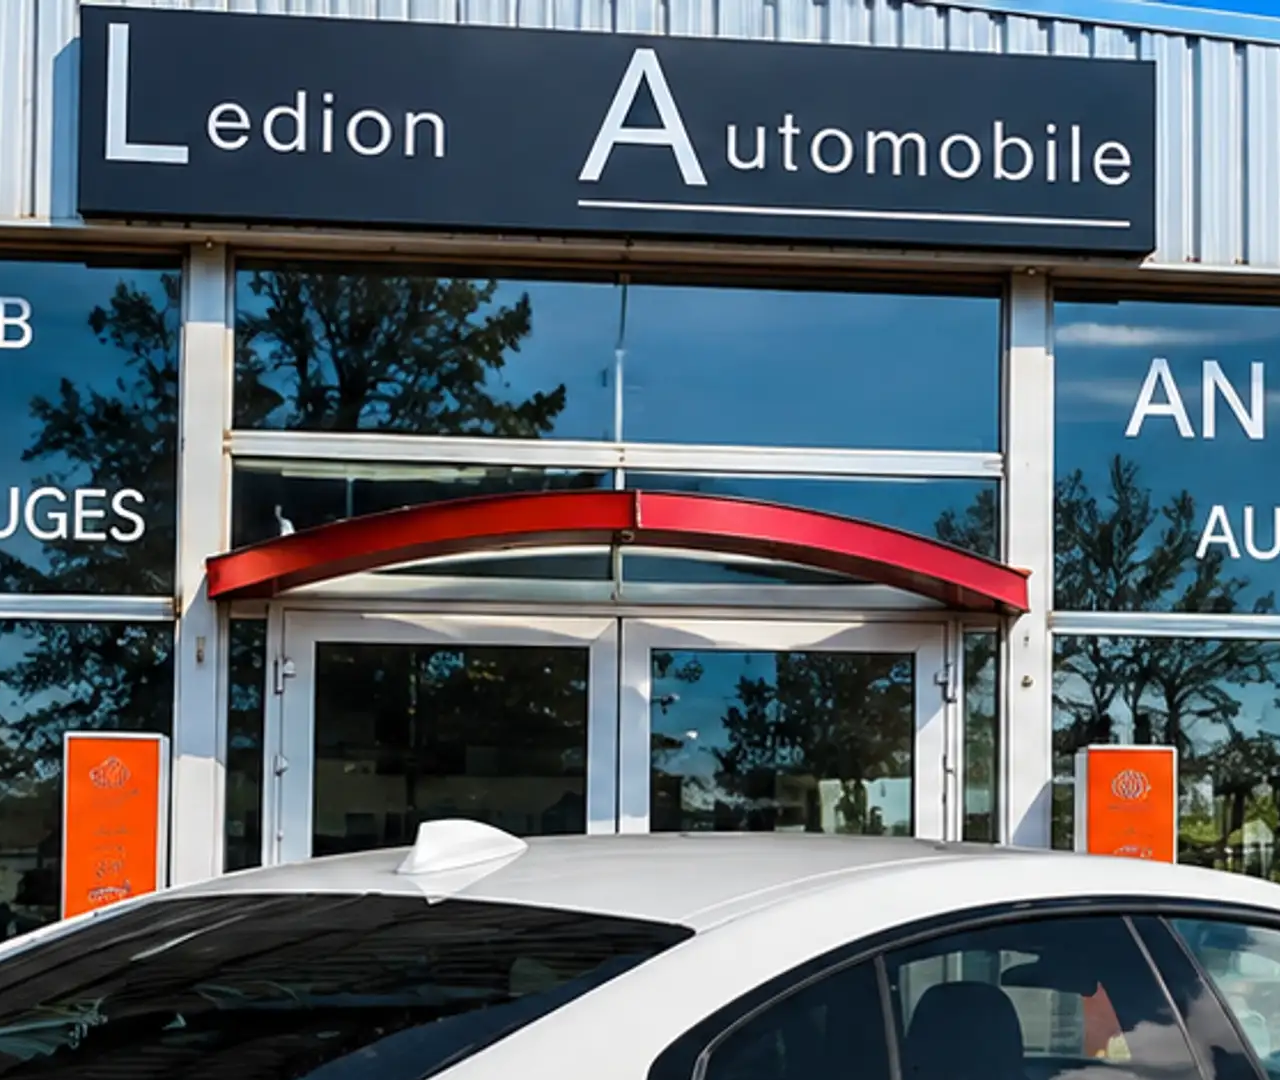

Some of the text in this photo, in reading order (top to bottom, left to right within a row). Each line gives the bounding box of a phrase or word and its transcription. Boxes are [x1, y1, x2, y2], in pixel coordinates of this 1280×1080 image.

[104, 21, 1133, 187] Ledion Automobile
[1124, 357, 1266, 440] AN
